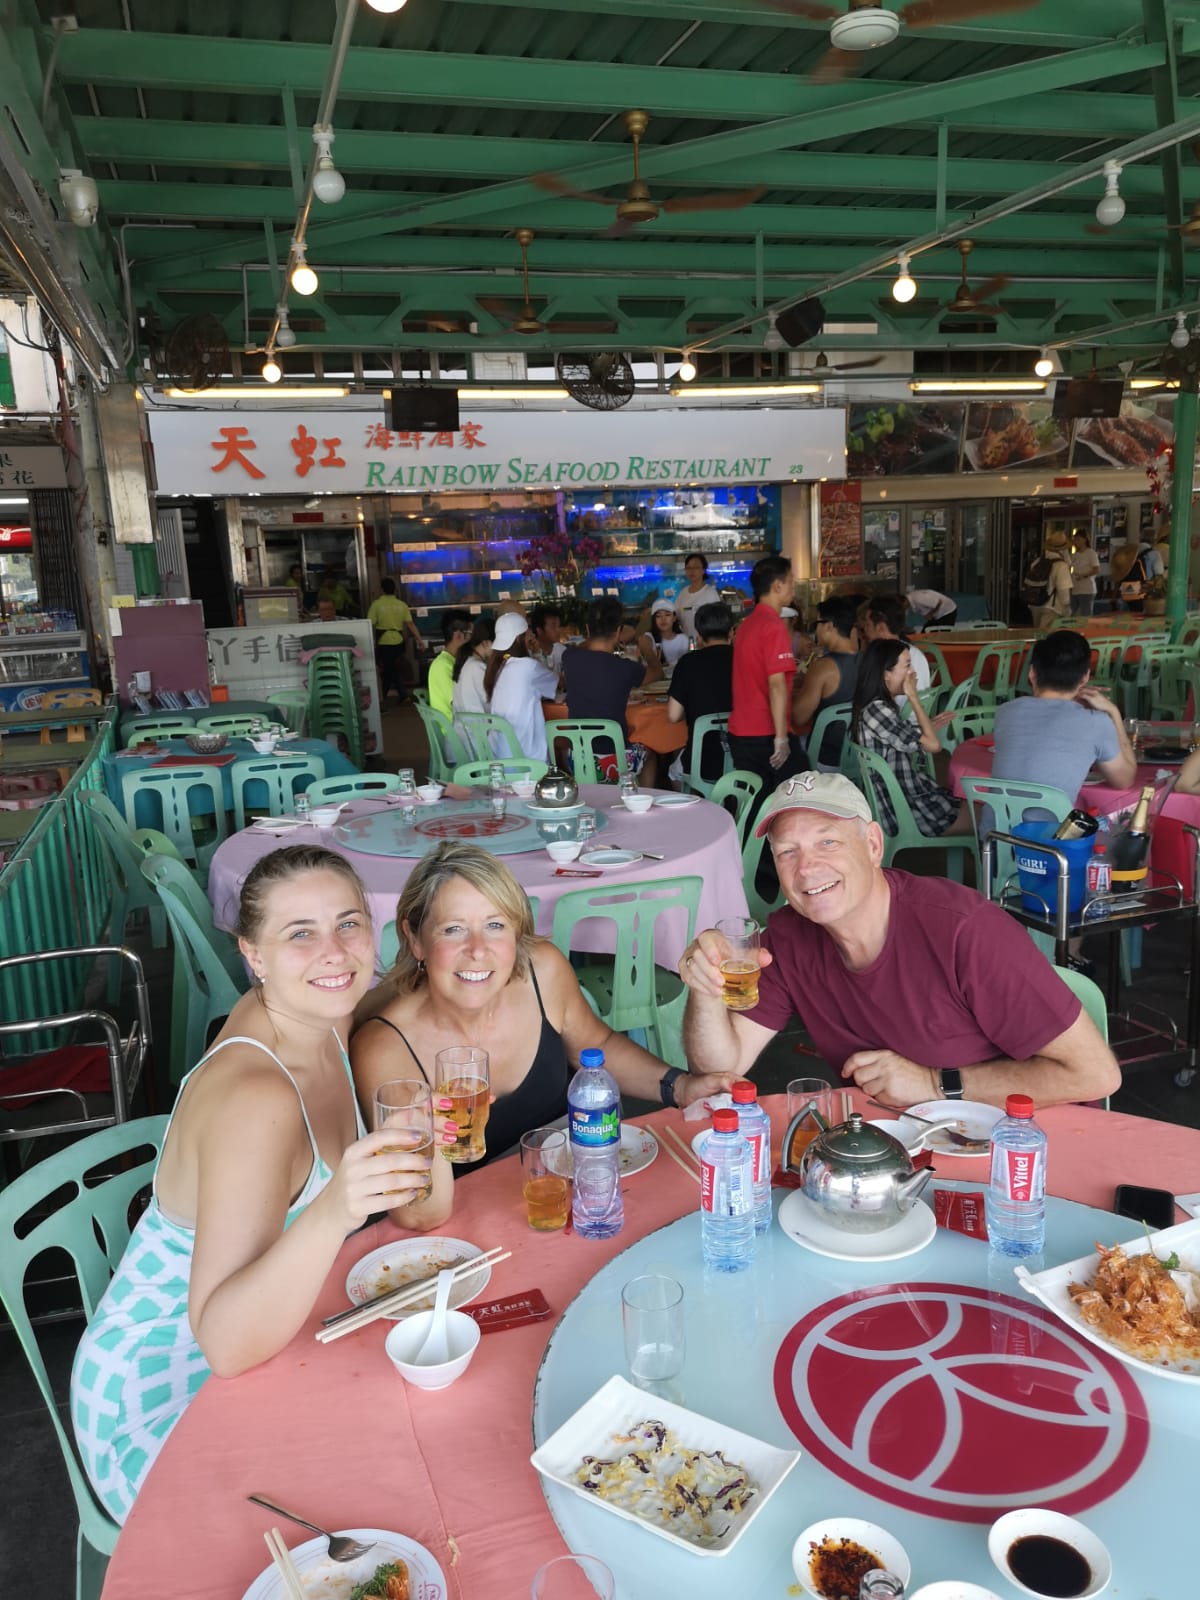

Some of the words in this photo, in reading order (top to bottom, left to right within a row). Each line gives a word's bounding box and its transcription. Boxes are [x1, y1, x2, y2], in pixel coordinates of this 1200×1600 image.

[365, 421, 487, 450] 海鮮酒家
[210, 423, 346, 479] 天虹
[365, 461, 502, 487] RAINBOW
[507, 456, 620, 484] SEAFOOD
[626, 456, 771, 480] RESTAURANT
[788, 464, 804, 474] 23
[1021, 857, 1046, 870] GIRL
[572, 1120, 613, 1135] Bonaqua
[1013, 1156, 1029, 1188] Vittel
